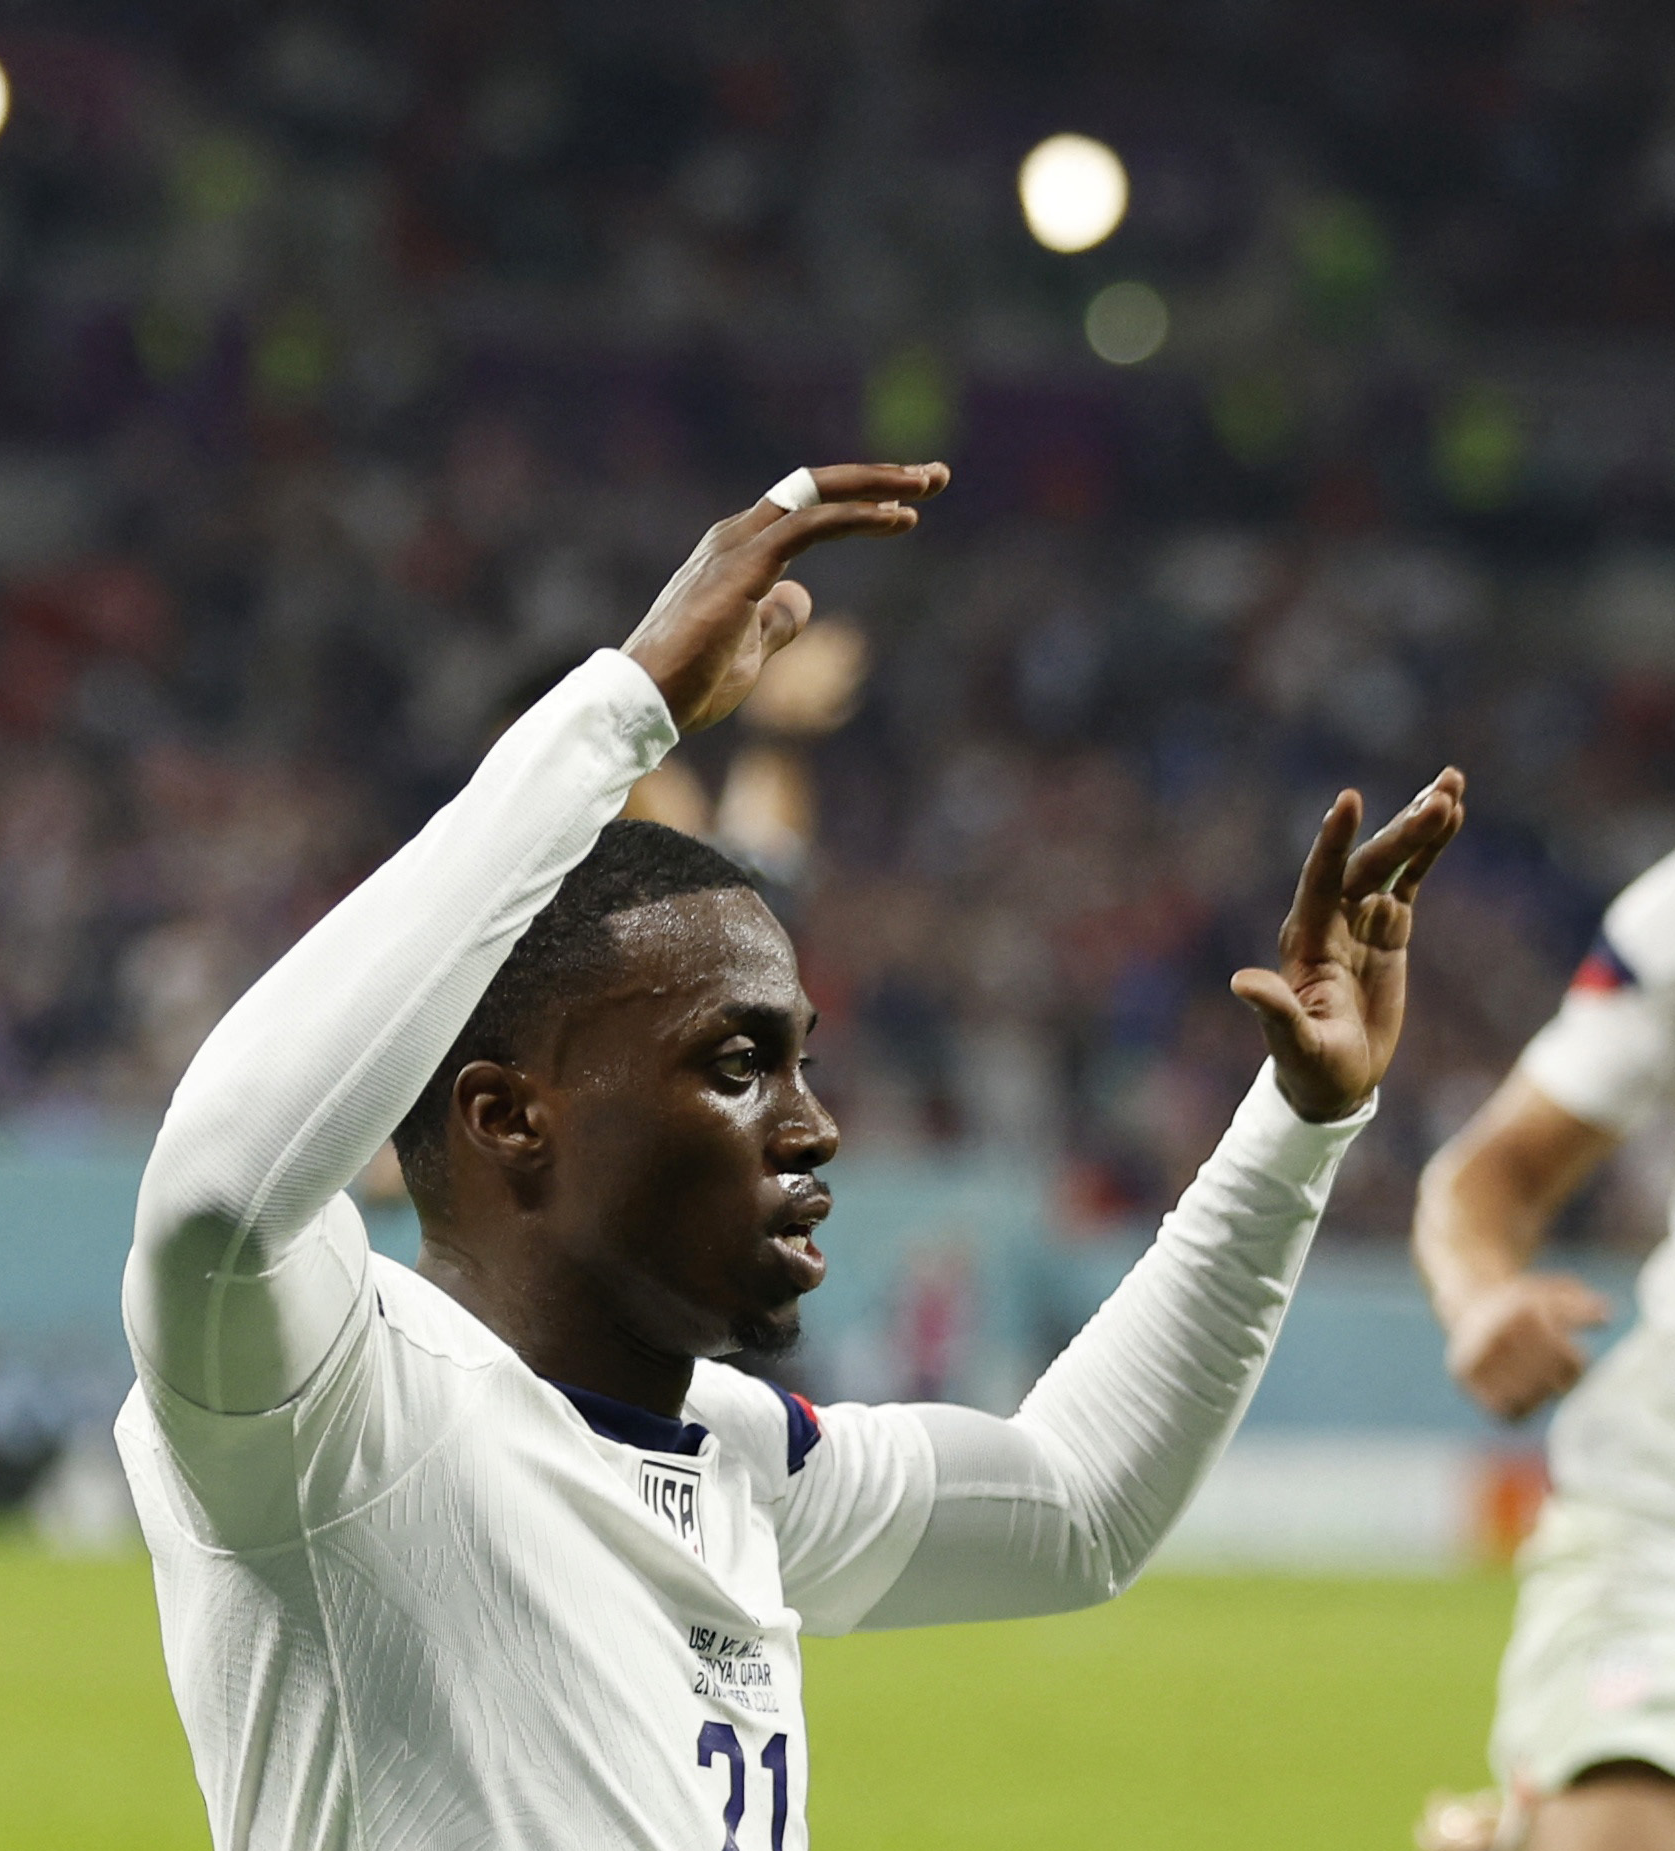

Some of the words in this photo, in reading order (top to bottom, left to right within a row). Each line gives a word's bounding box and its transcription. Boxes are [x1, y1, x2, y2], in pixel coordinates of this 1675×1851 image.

[644, 1473, 694, 1540] USA
[688, 1625, 717, 1652] USA
[693, 1671, 710, 1695] 21
[740, 1662, 772, 1687] QATAR
